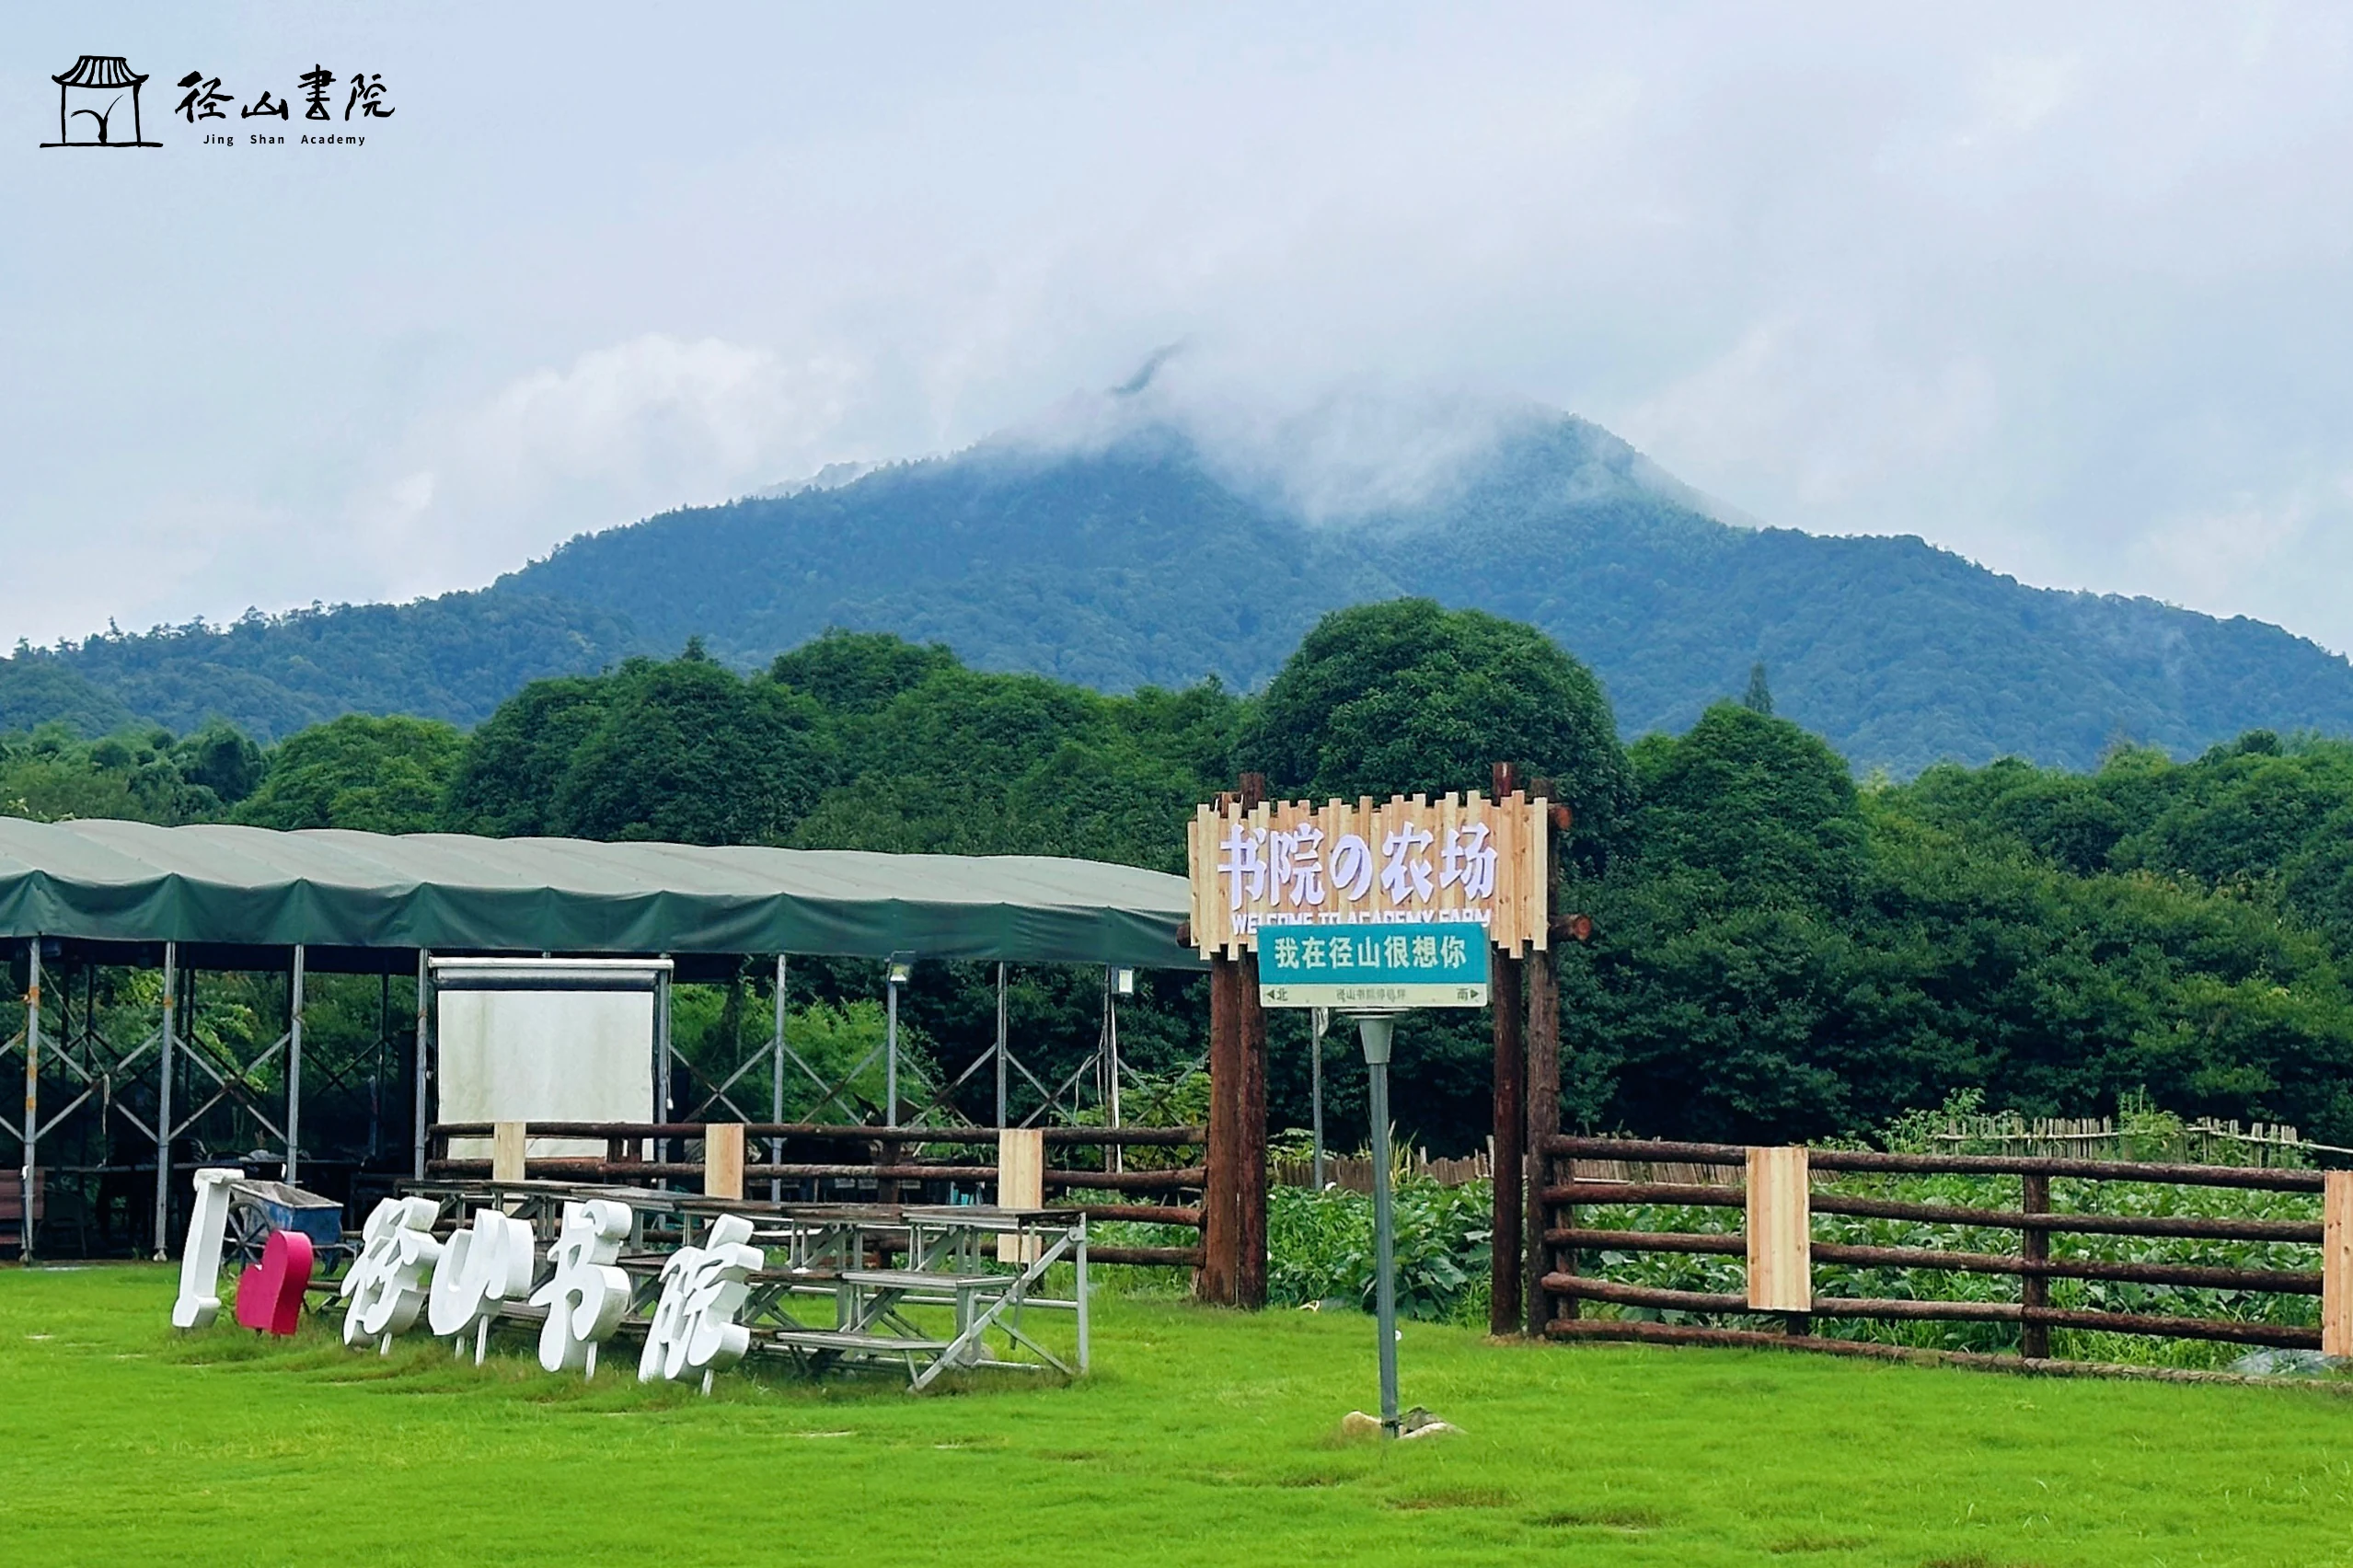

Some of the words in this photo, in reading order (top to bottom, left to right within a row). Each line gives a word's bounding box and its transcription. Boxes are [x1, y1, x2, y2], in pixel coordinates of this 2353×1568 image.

[1217, 822, 1498, 910] 书院の农场
[1275, 935, 1467, 969] 我在径山很想你
[1276, 987, 1288, 1002] 北
